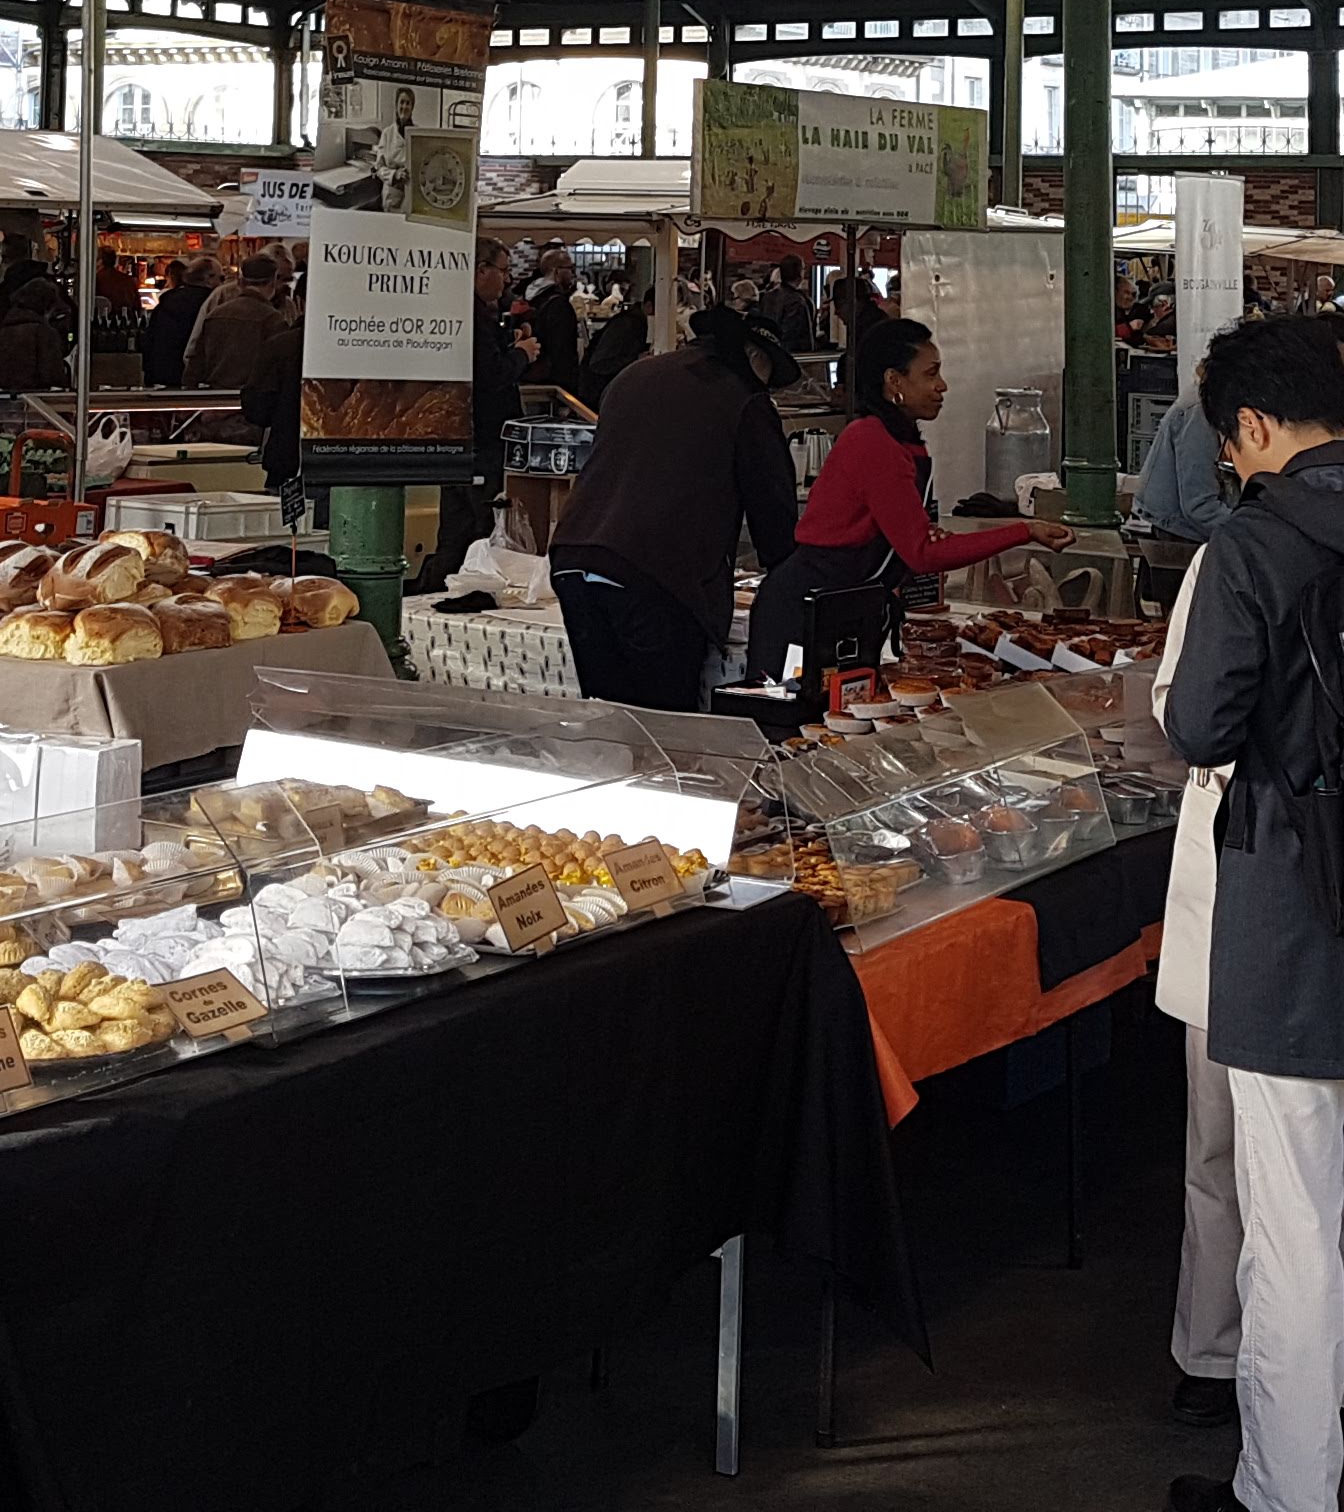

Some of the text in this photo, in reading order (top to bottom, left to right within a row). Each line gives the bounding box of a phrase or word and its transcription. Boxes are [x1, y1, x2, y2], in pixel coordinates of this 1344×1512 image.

[869, 107, 934, 130] LA FERME
[801, 125, 821, 146] LA
[878, 132, 899, 152] DU
[907, 134, 934, 155] VAL
[260, 181, 310, 199] JUS DE
[323, 243, 471, 271] KOUIGN AMANN
[368, 269, 430, 295] PRIMÉ
[327, 315, 464, 336] Trophée d'OR 2017
[337, 338, 349, 347] au
[351, 338, 391, 348] concours
[392, 339, 404, 349] de
[497, 879, 545, 911] Amandes
[629, 875, 666, 893] Citron
[515, 909, 544, 930] Noix
[169, 982, 228, 1003] Cornes
[186, 999, 248, 1024] Gazelle
